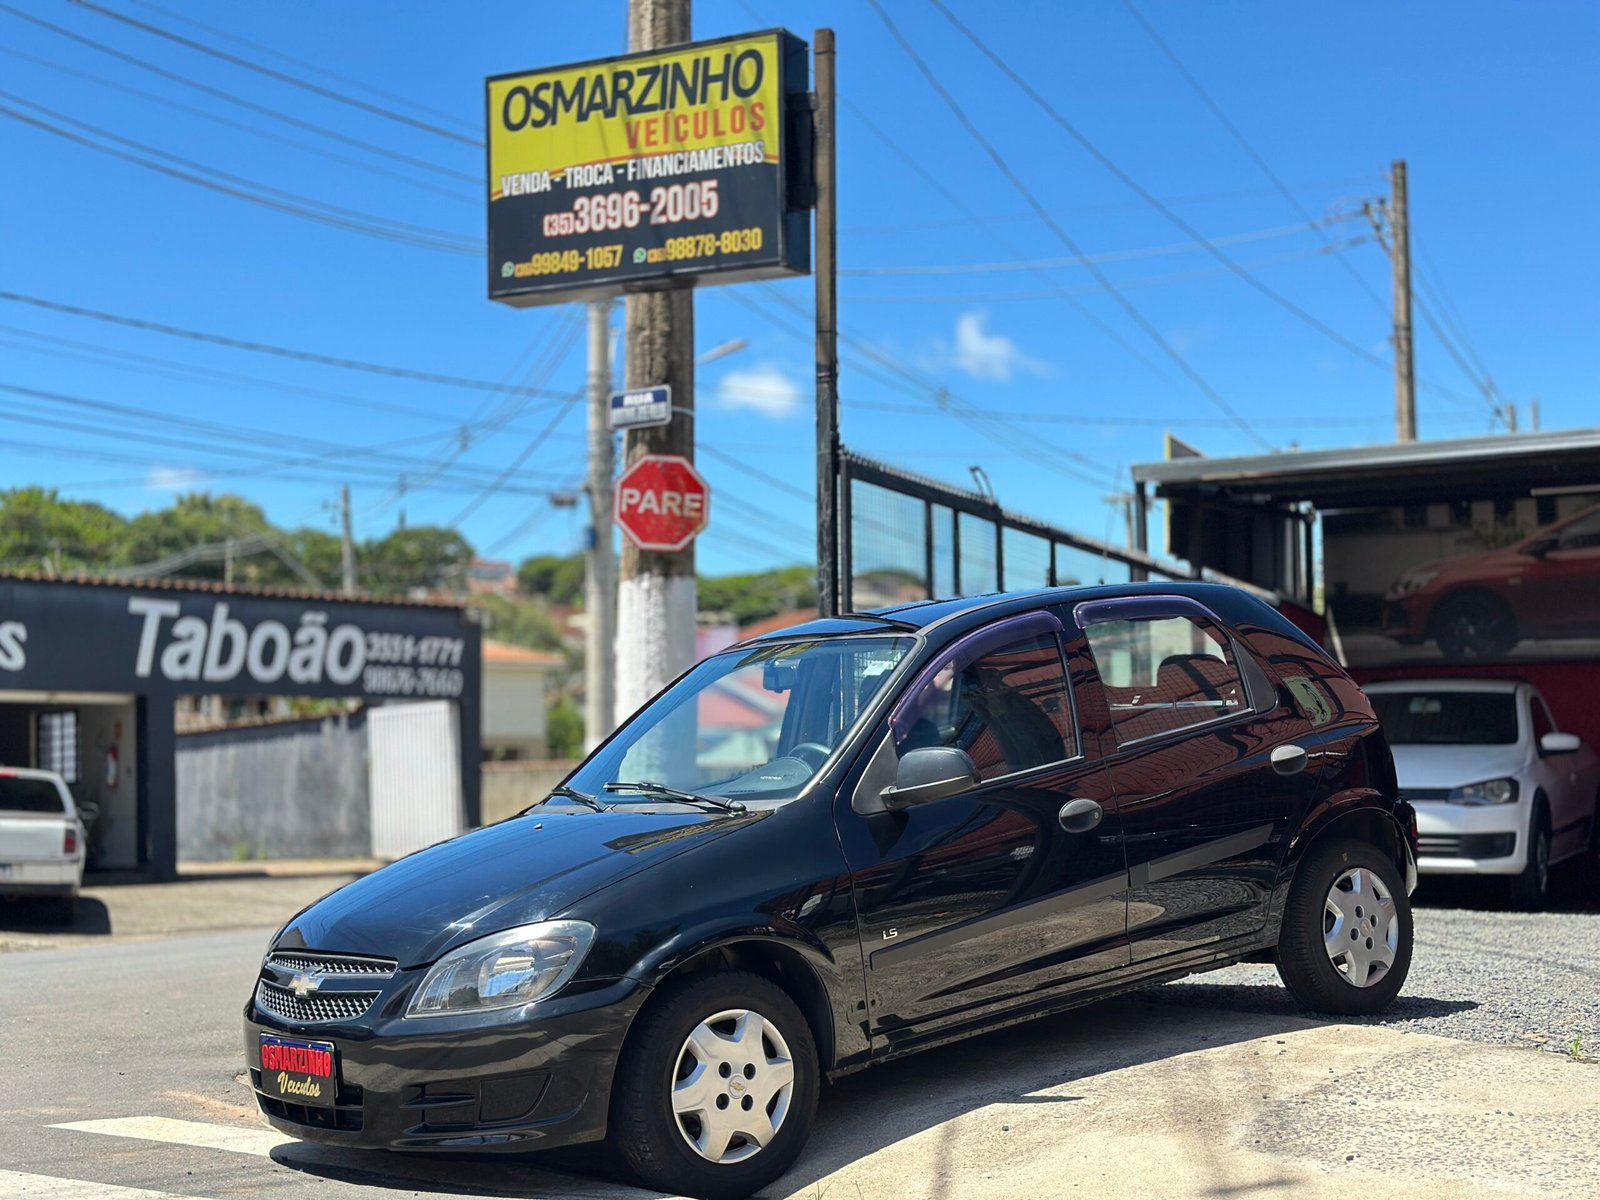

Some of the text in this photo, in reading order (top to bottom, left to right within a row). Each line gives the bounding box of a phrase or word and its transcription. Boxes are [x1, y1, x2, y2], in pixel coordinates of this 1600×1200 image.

[503, 49, 764, 132] OSMARZINHO
[626, 101, 766, 149] VEÍCULOS
[501, 170, 551, 197] VENDA
[564, 164, 614, 189] TROCA
[627, 141, 765, 181] FINANCIAMENTOS
[621, 488, 703, 517] PARE
[128, 597, 366, 684] Taboão
[882, 928, 898, 940] LS
[262, 1044, 331, 1078] OSMARZINHO
